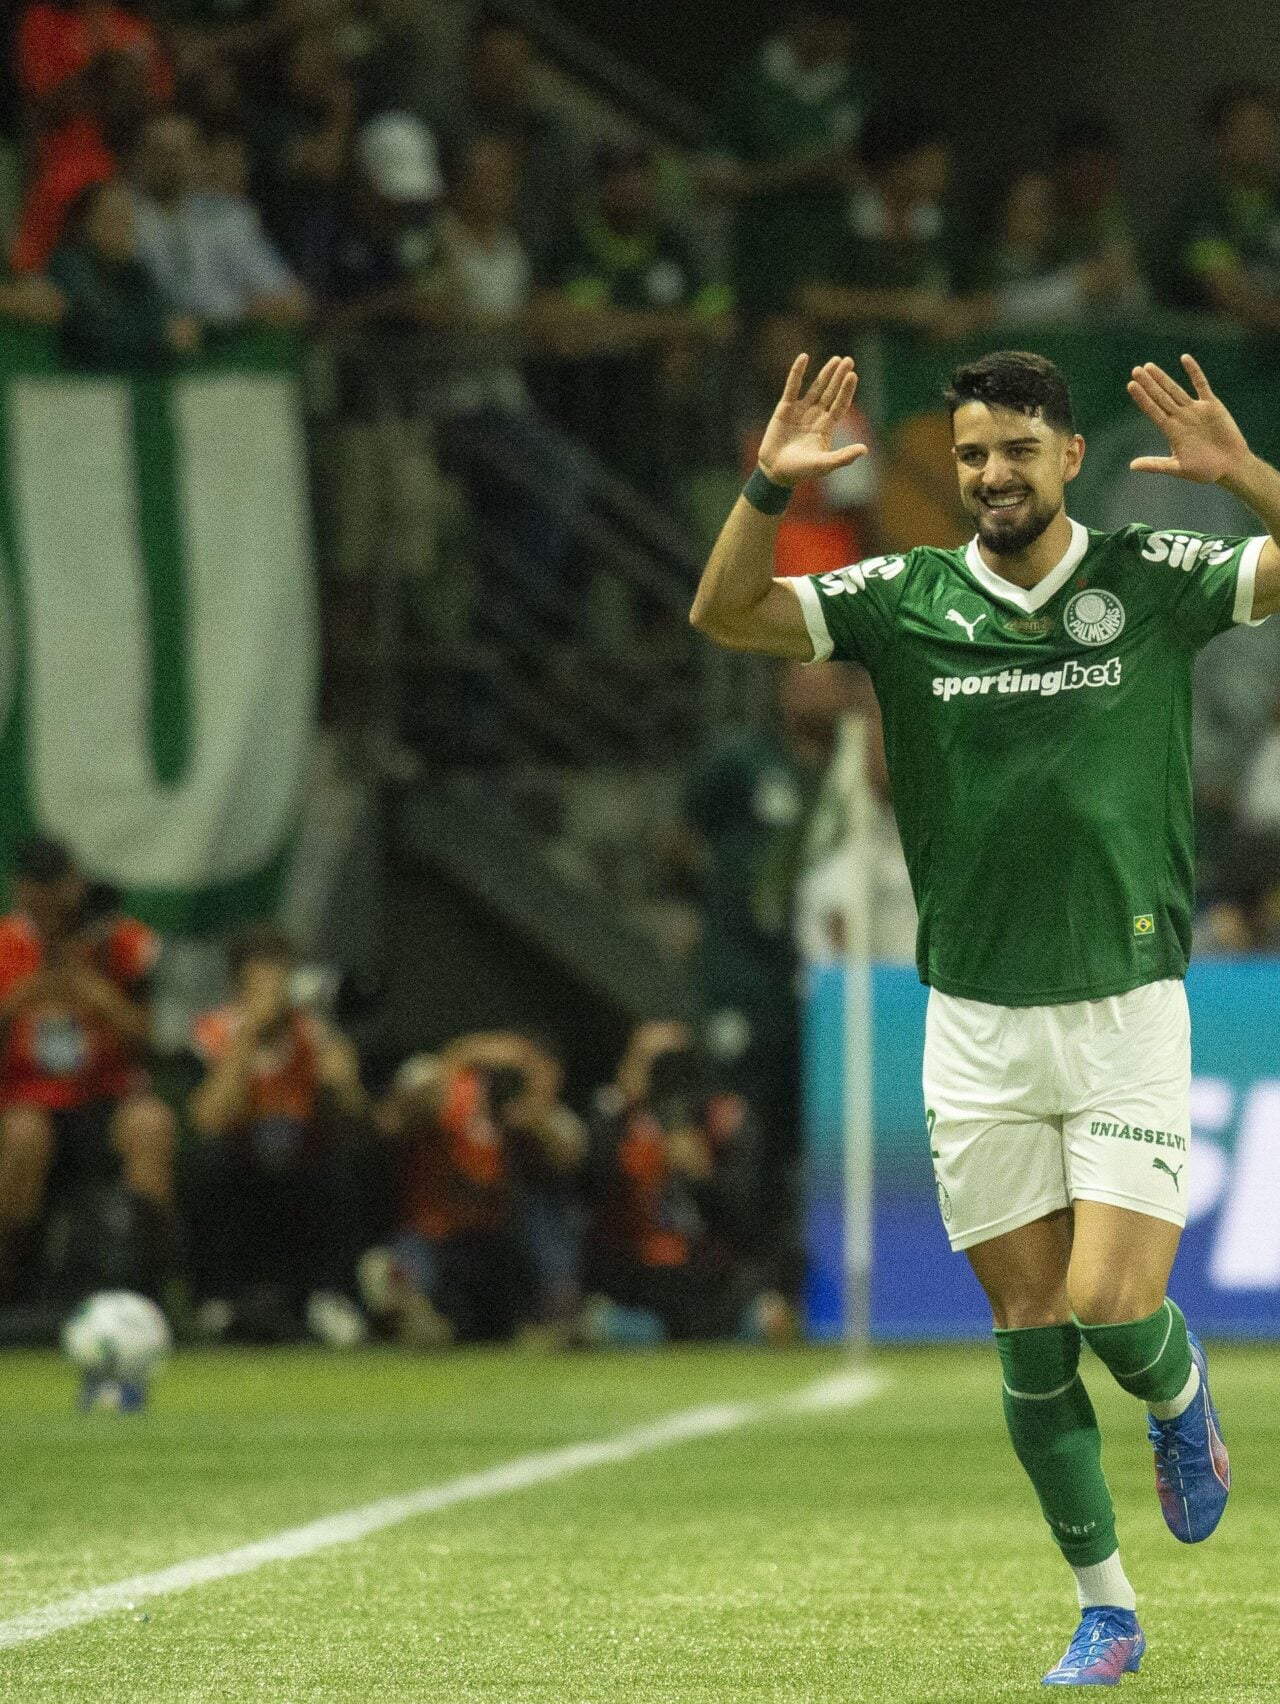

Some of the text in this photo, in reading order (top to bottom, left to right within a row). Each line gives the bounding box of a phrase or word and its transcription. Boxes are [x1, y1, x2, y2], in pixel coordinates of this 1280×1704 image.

[1069, 607, 1121, 642] PALMEIRAS
[932, 656, 1122, 702] sportingbet
[1090, 1121, 1186, 1152] UNIASSELVI
